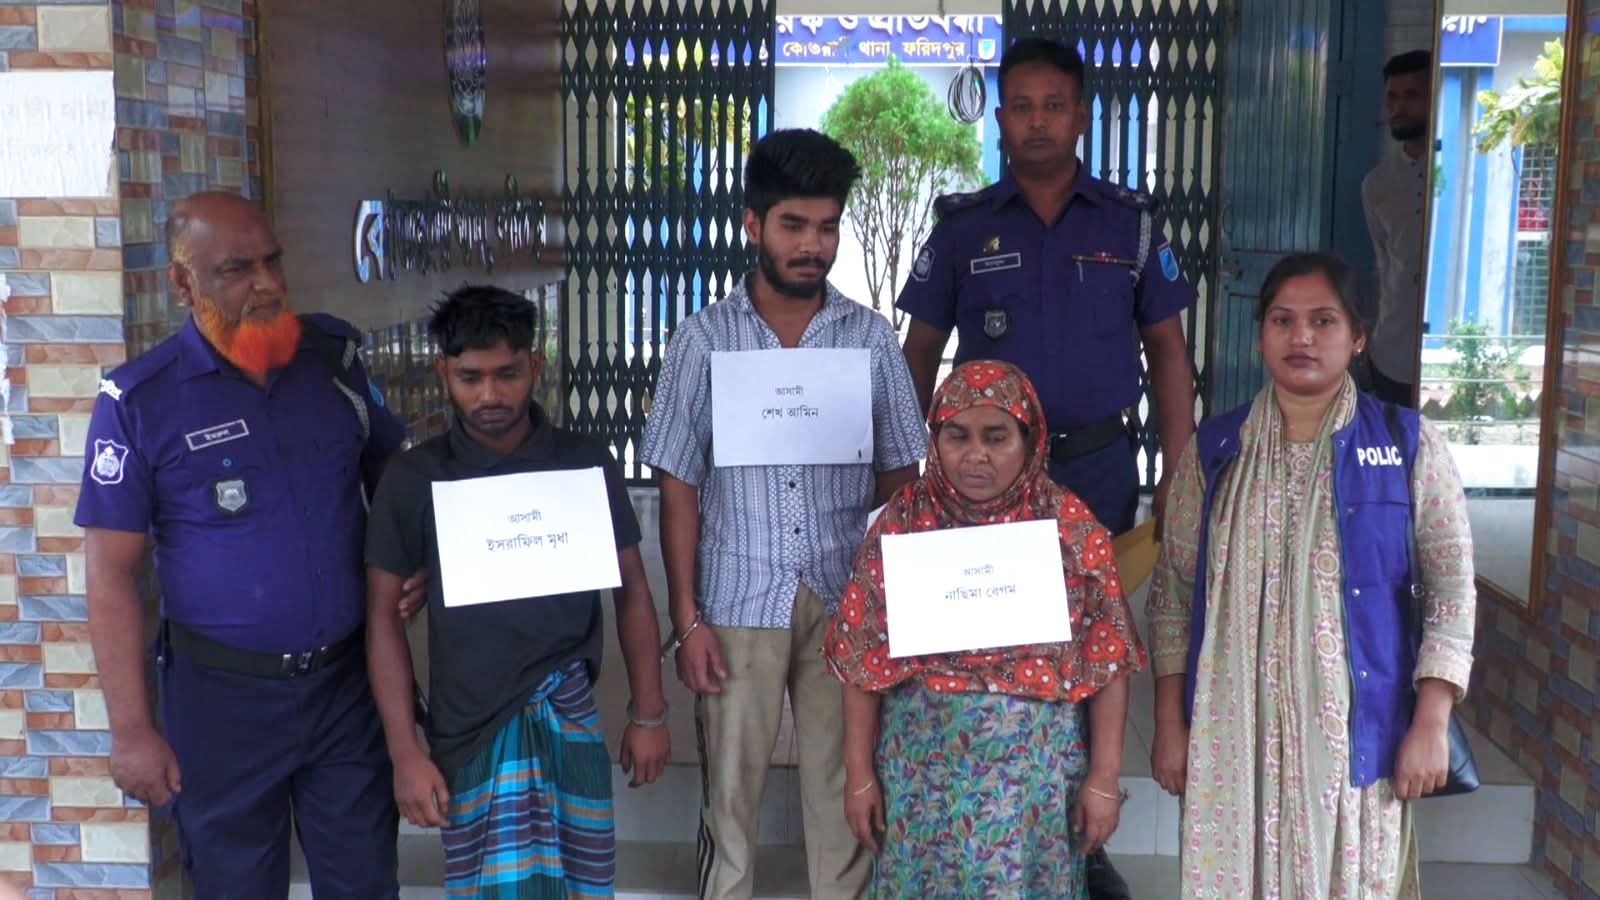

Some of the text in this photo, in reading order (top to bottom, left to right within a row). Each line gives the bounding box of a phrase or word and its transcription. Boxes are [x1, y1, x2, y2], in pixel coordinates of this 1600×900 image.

[902, 37, 965, 60] ফরিদপুর
[775, 385, 804, 397] আসামী
[762, 404, 819, 420] শেখ আমিন
[1356, 446, 1403, 467] POLIC
[508, 509, 542, 524] আসামী
[486, 533, 544, 553] ইসরাফিল
[963, 564, 994, 577] আসামী
[944, 584, 1016, 601] নাছিমা বেগম
